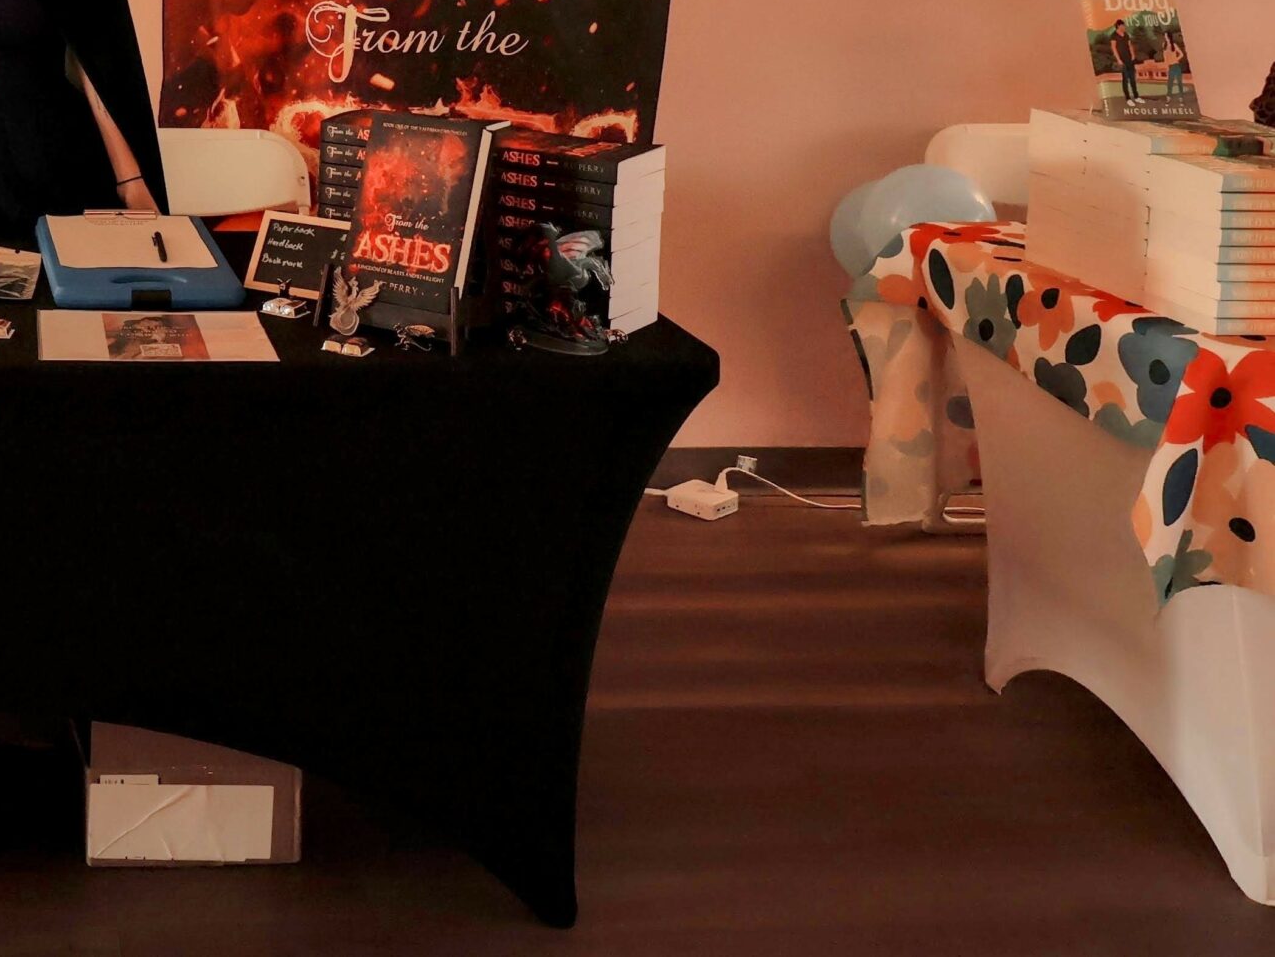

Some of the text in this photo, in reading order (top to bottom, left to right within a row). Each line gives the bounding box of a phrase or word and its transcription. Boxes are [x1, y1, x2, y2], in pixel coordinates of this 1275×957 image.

[305, 0, 529, 83] From the
[1123, 107, 1158, 115] NICOLE
[502, 150, 540, 167] ASHES
[501, 172, 537, 187] ASHES
[499, 194, 536, 211] ASHES
[384, 213, 430, 231] From the
[353, 230, 452, 274] ASHES
[389, 282, 418, 295] PERRY
